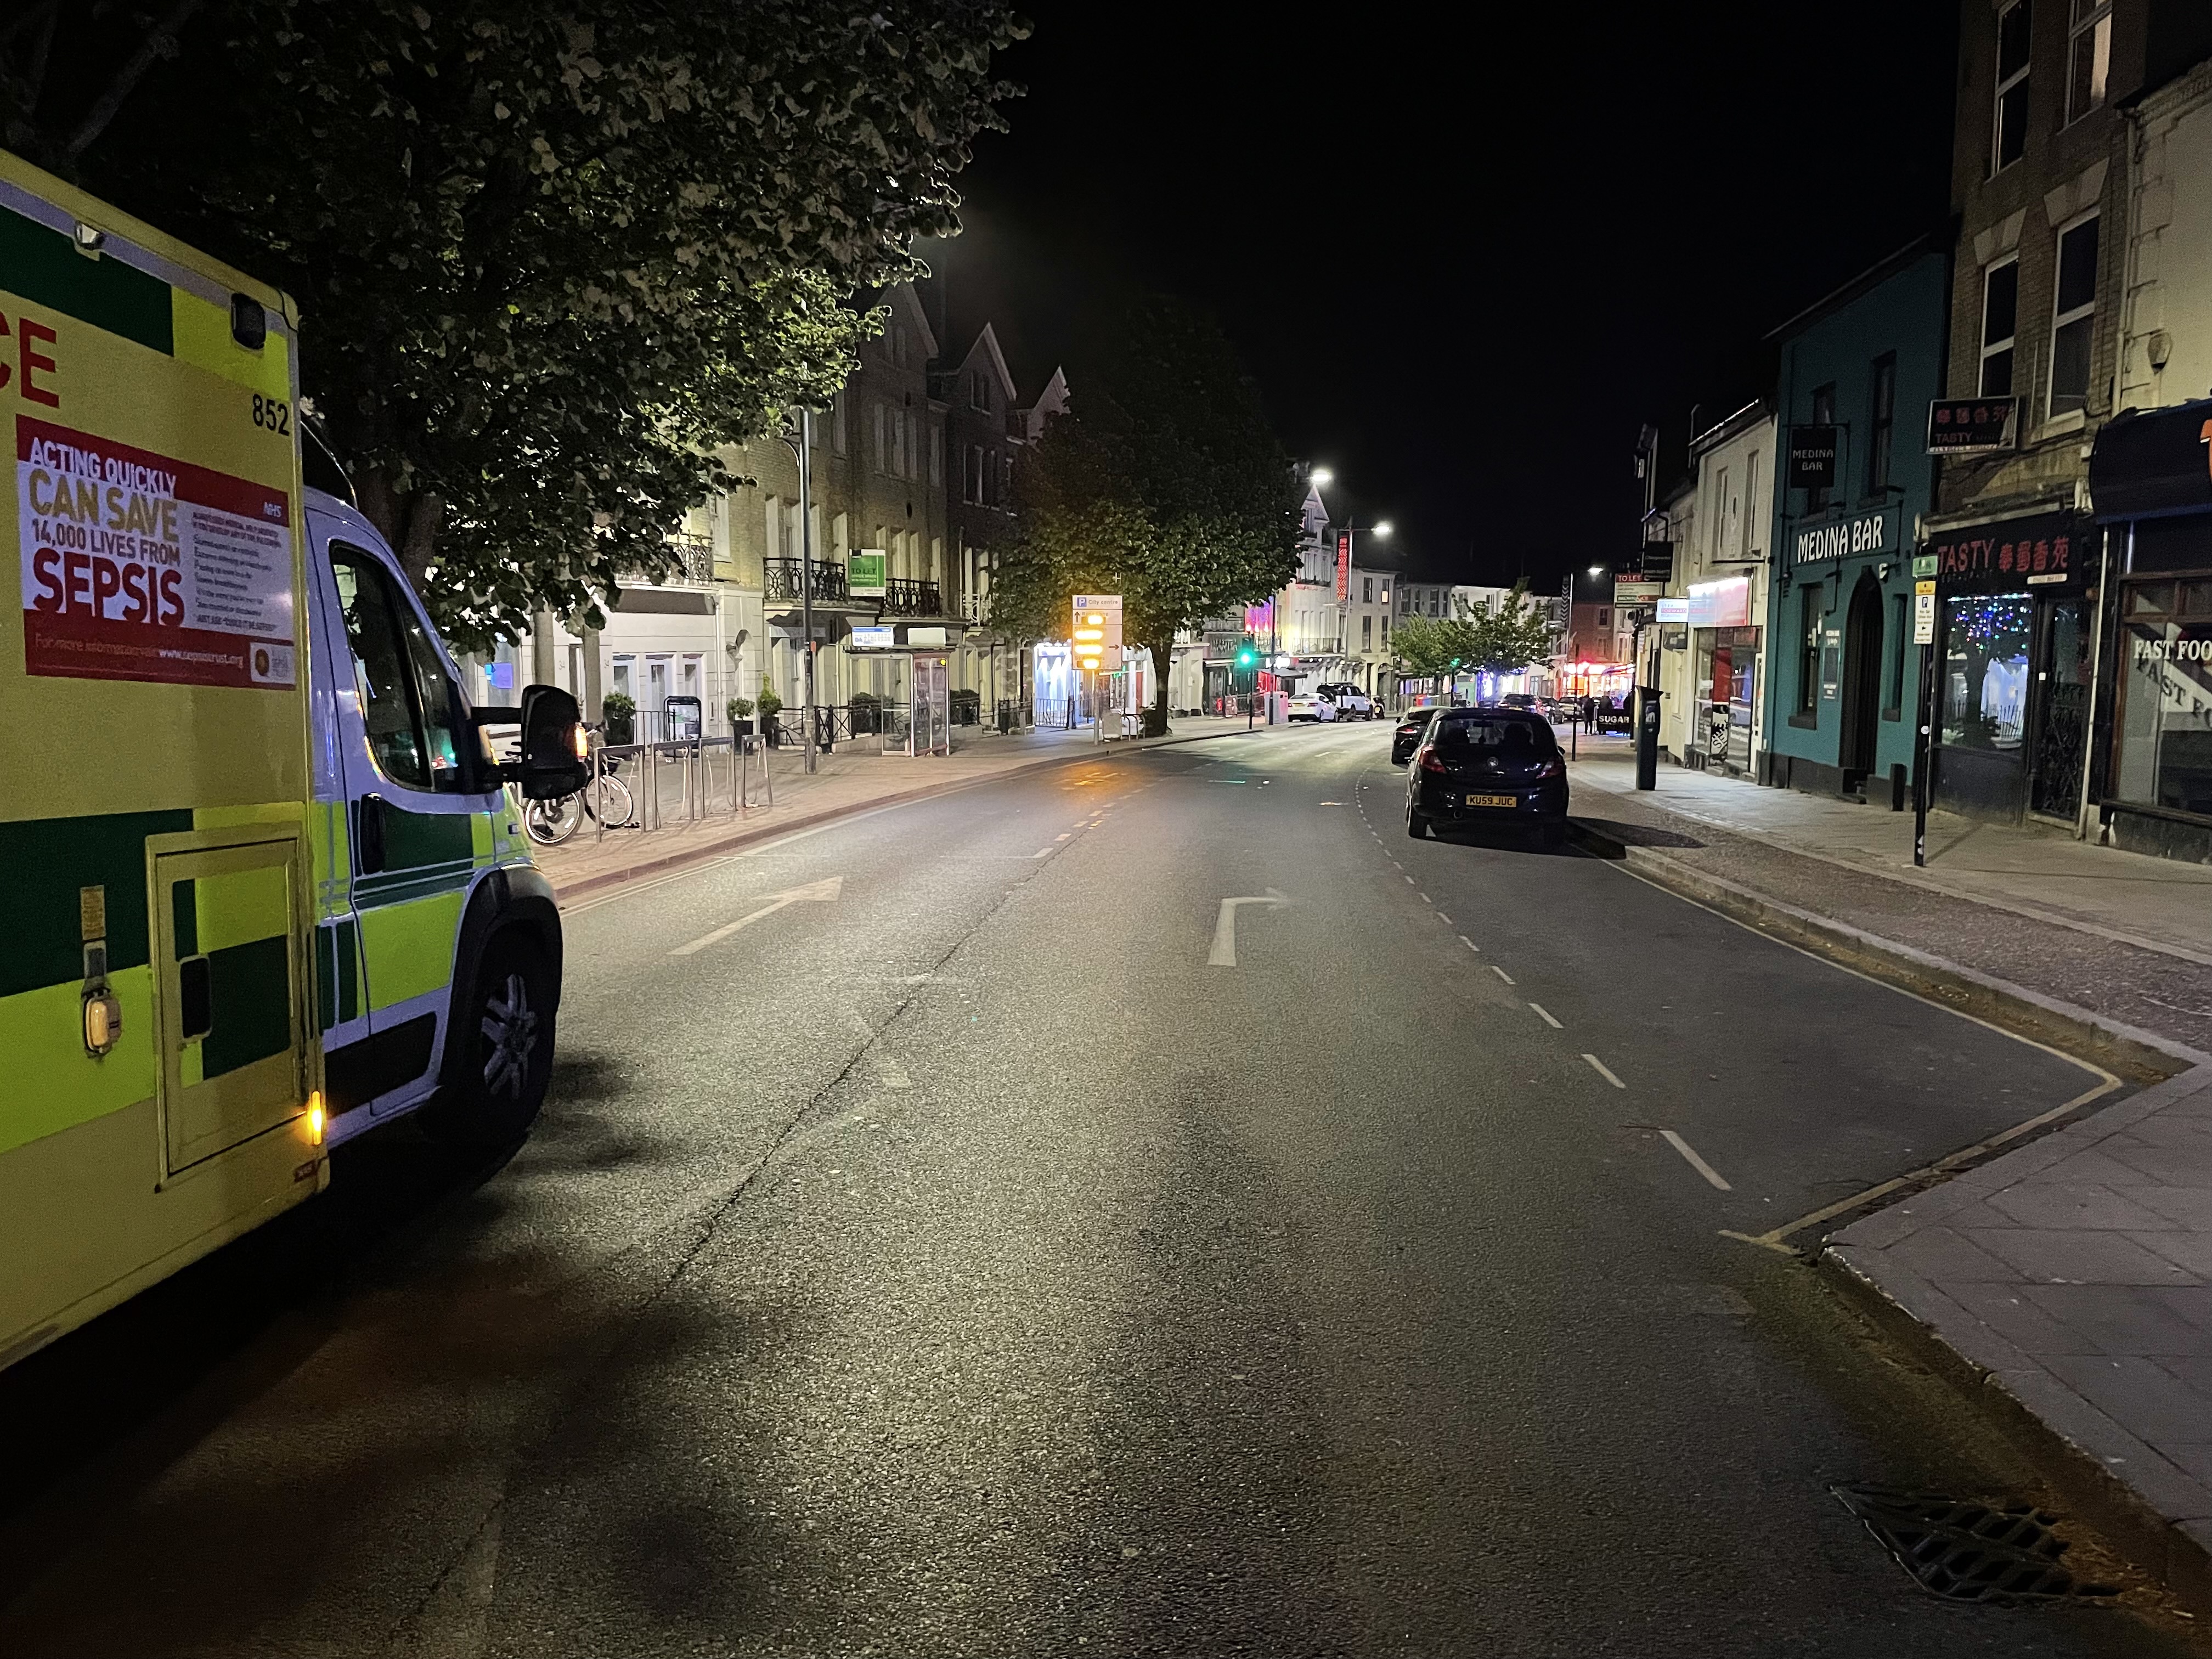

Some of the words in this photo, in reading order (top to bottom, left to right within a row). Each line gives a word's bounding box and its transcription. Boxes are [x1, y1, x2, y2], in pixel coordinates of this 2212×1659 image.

[0, 311, 59, 408] E
[253, 394, 290, 436] 852
[1793, 449, 1833, 459] MEDINA
[1936, 432, 1972, 444] TASTY
[30, 437, 101, 479] ACTING
[105, 458, 176, 498] QUICKLY
[1802, 461, 1822, 471] BAR
[30, 469, 99, 527] CAN
[106, 487, 179, 543] SAVE
[32, 518, 86, 550] 14,000
[90, 529, 137, 558] LIVES
[140, 539, 181, 566] FROM
[1798, 524, 1848, 563] MEDINA
[1853, 515, 1883, 552] BAR
[1937, 538, 1996, 574] TASTY
[33, 547, 185, 627] SEPSIS
[1079, 598, 1086, 607] P
[2133, 640, 2175, 659] FAST
[1470, 796, 1493, 805] KU59
[1495, 797, 1513, 805] JUC
